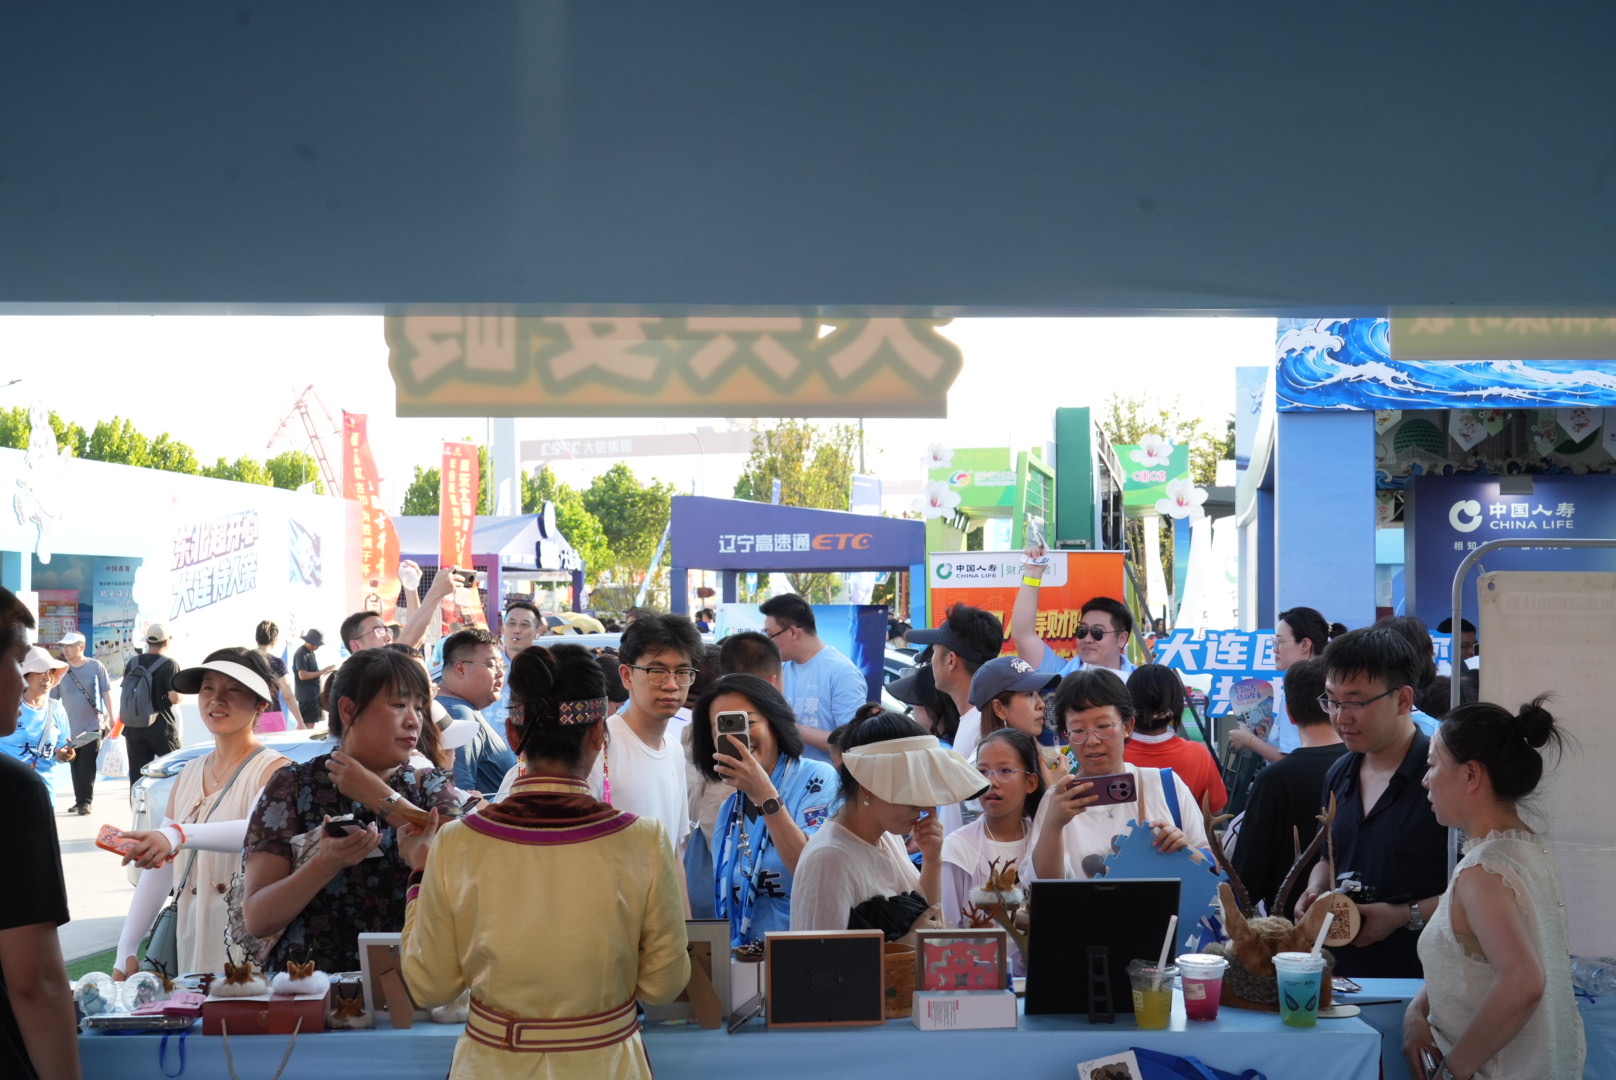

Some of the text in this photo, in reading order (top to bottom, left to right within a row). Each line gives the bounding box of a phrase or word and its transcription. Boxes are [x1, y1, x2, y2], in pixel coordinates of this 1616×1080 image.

[1489, 501, 1576, 519] 中国人寿
[1490, 520, 1575, 530] CHINA LIFE
[719, 533, 874, 553] 辽宁高速通 ETC
[956, 564, 998, 573] 中国人寿
[168, 553, 259, 621] 大连待人亲
